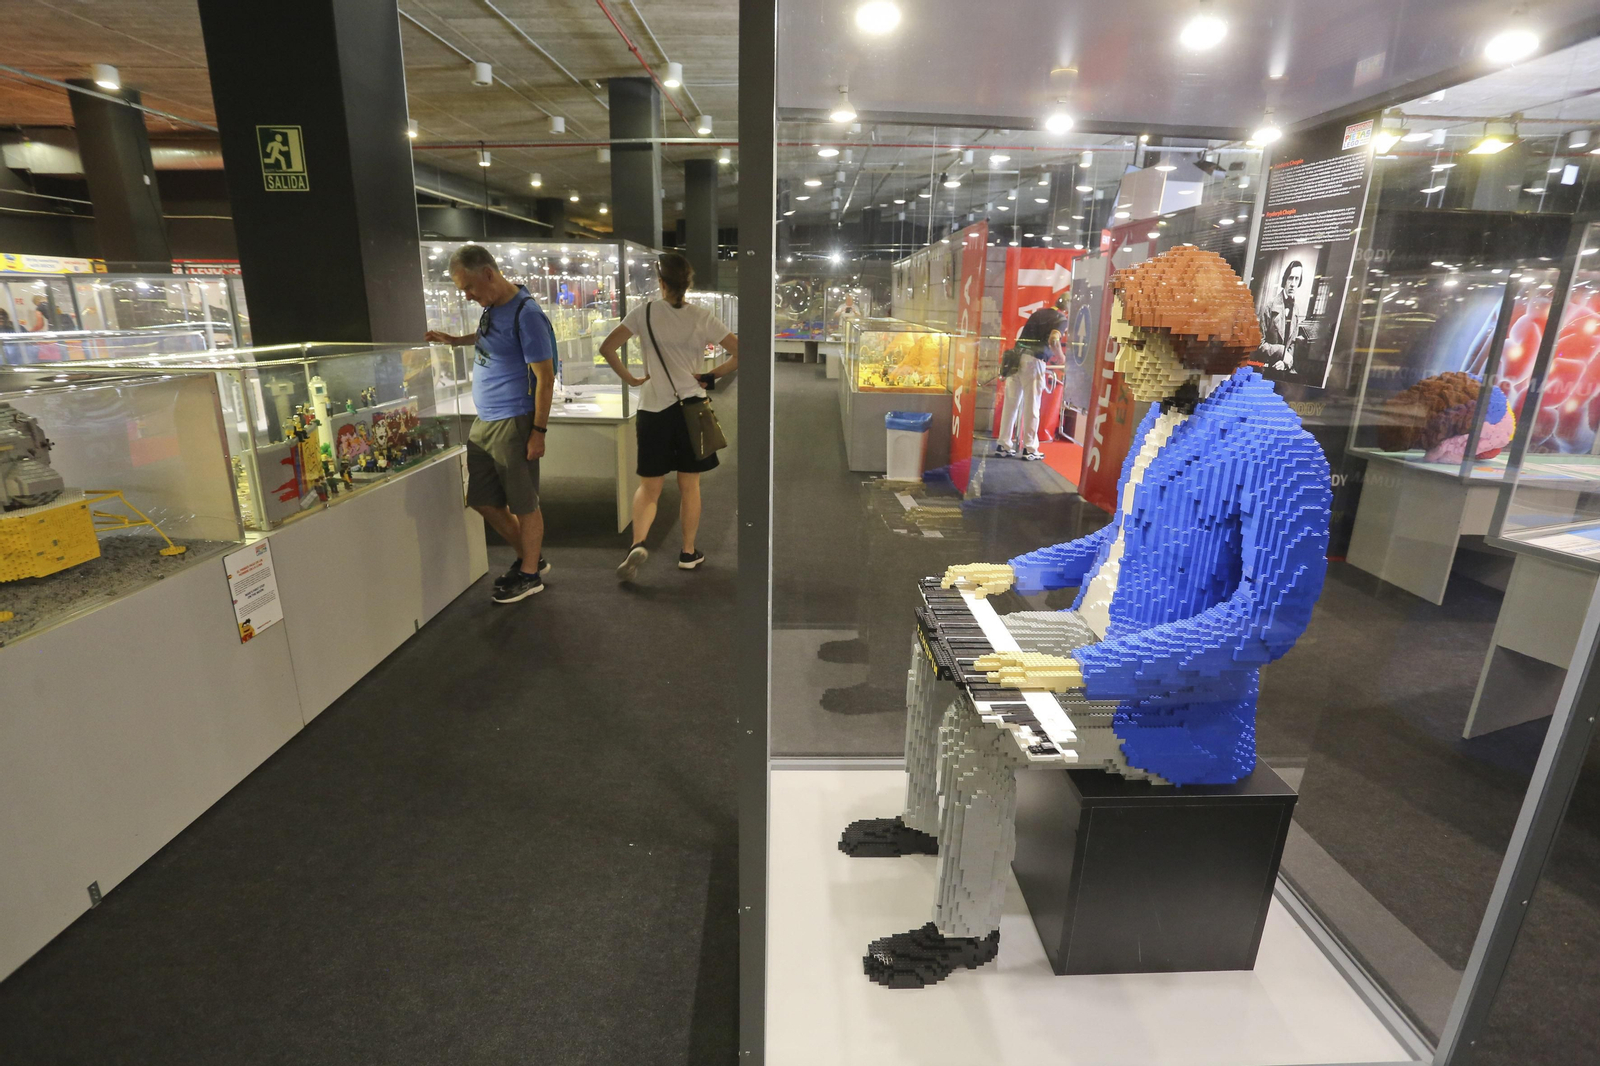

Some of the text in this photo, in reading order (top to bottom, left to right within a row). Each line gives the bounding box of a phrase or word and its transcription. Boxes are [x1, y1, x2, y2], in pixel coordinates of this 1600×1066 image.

[1345, 130, 1371, 143] PIEZAS
[1343, 140, 1359, 149] LEGO
[267, 175, 306, 189] SALIDA
[1355, 248, 1396, 263] BODY
[952, 275, 972, 438] SALIDA
[1086, 334, 1118, 473] SALID
[1331, 473, 1349, 487] DY
